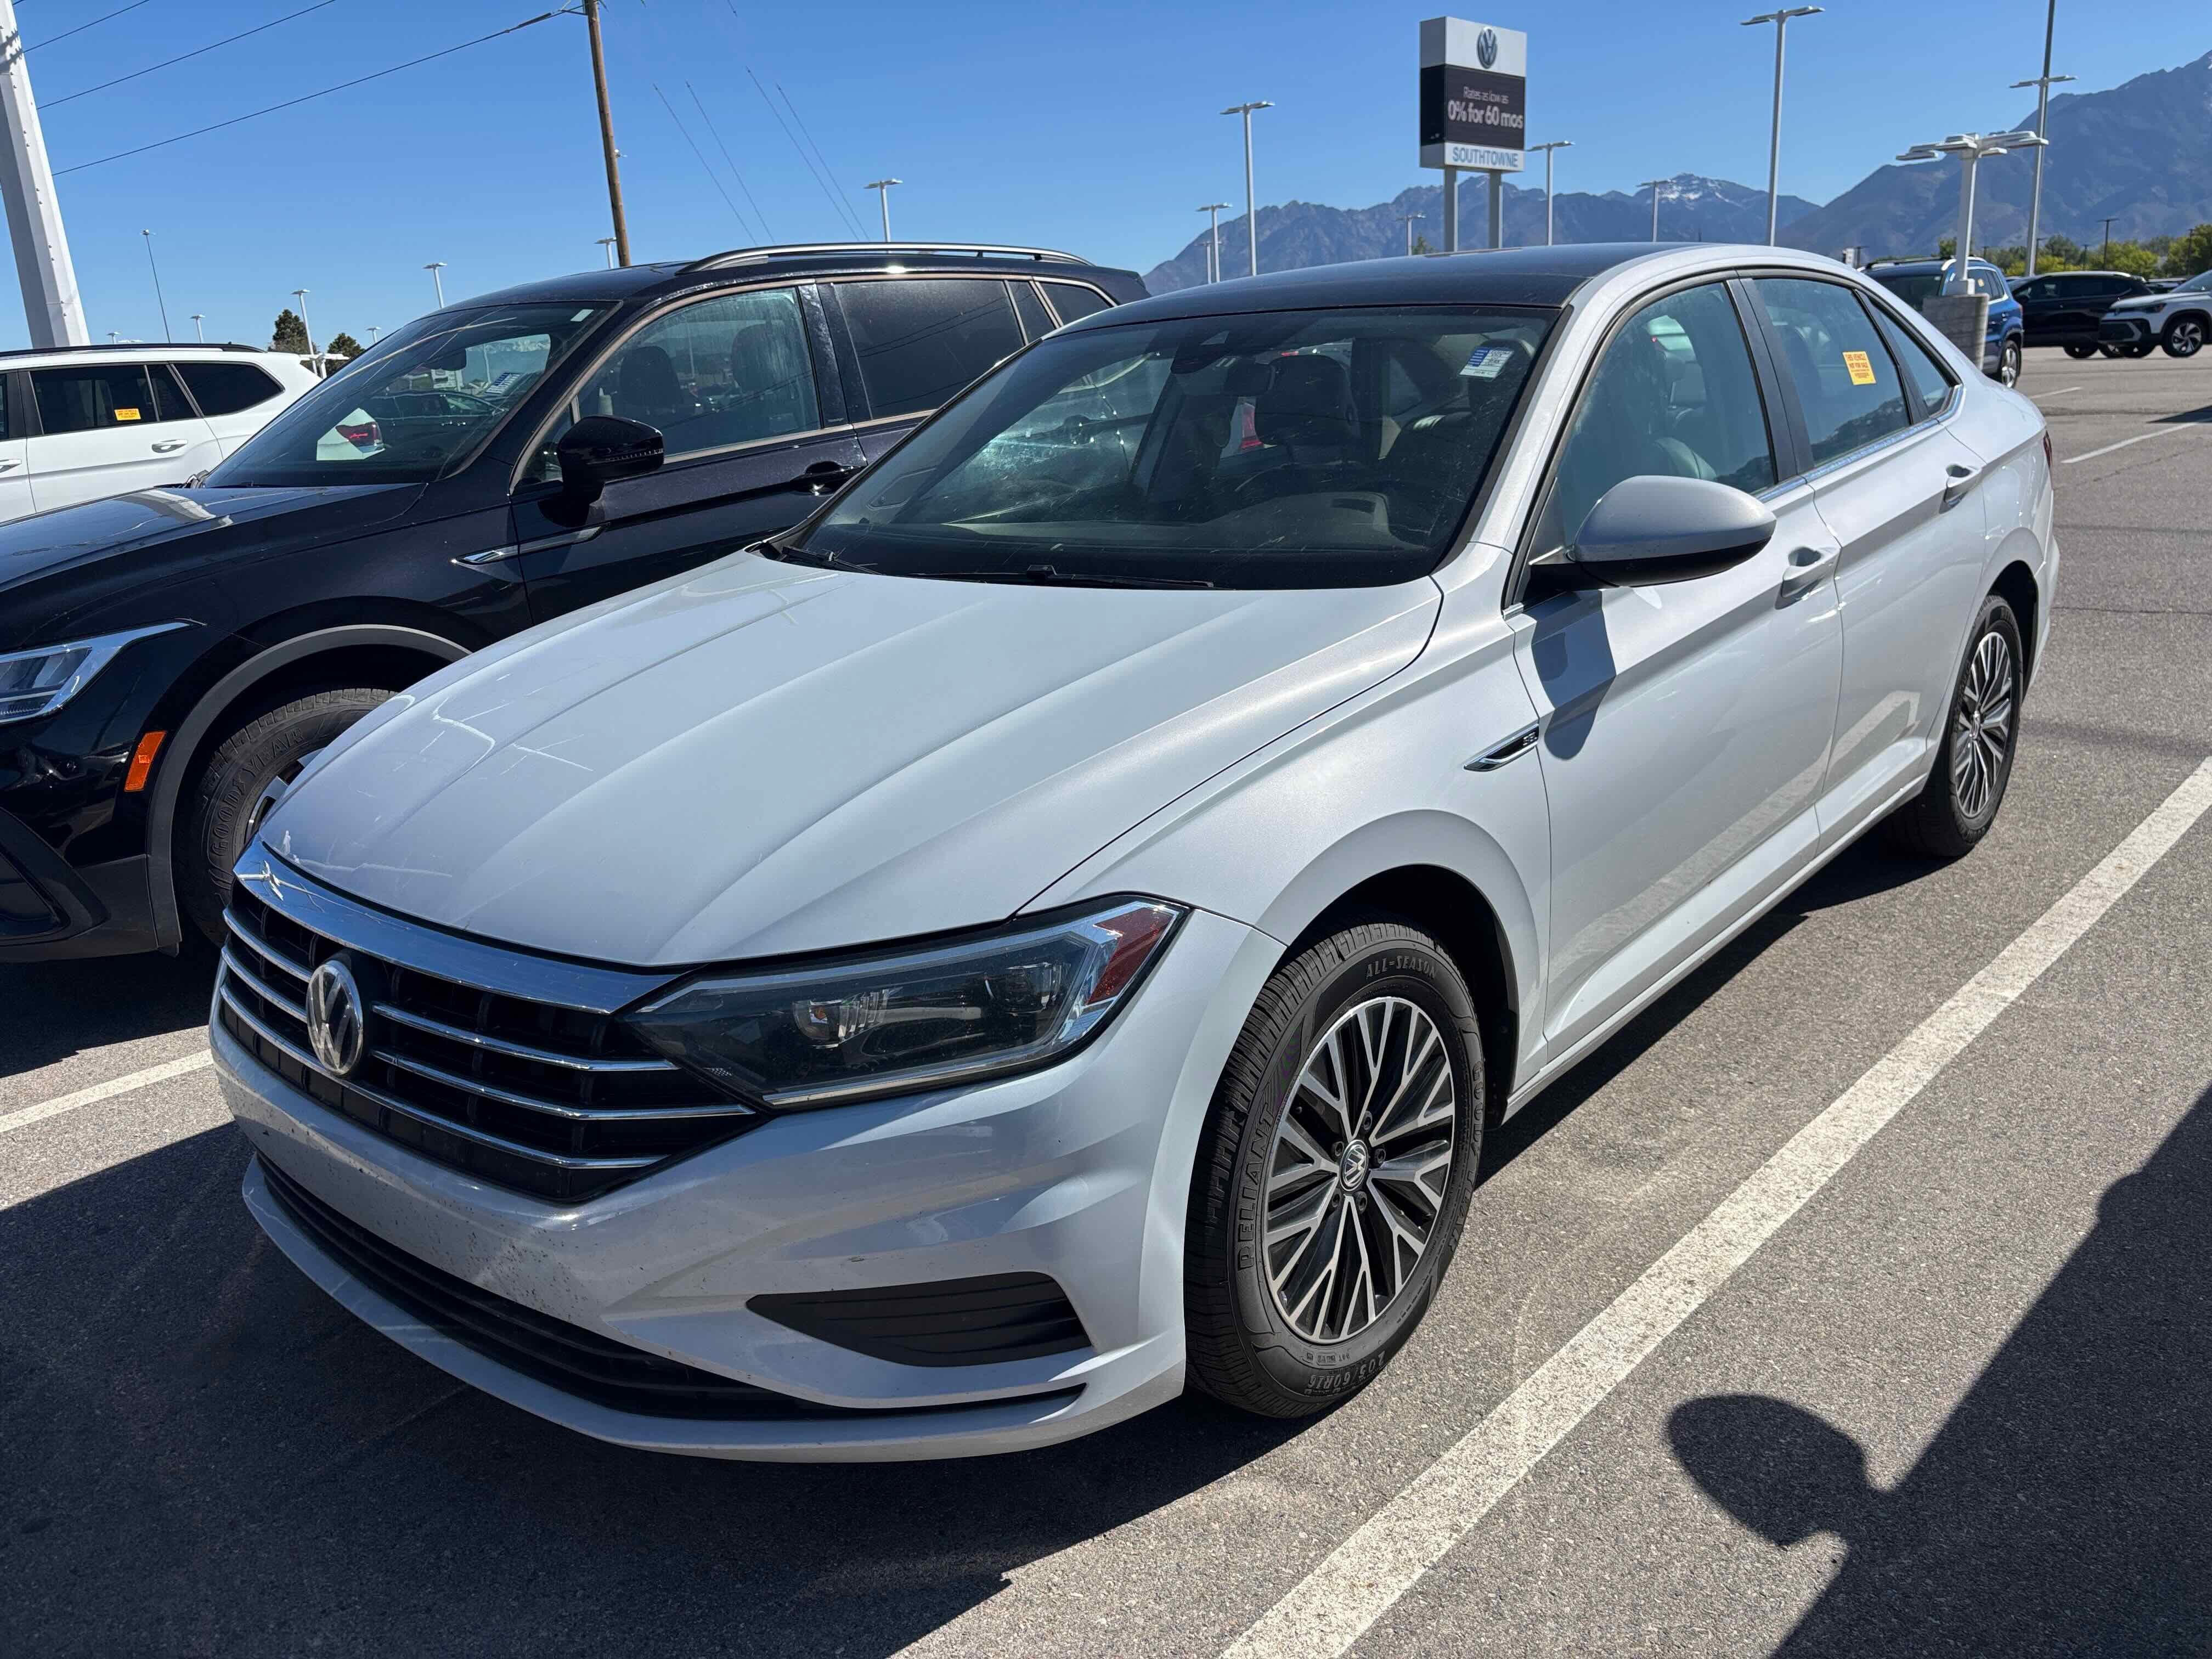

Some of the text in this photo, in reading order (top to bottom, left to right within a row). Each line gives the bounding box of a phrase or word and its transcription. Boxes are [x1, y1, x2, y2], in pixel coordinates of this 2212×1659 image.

[1463, 86, 1480, 100] Rates
[1448, 100, 1523, 129] 0% for 60 mos
[1452, 146, 1519, 167] SOUTHTOWNE
[1366, 956, 1436, 979] ALL-SEASON
[1238, 1102, 1274, 1271] RELIANT
